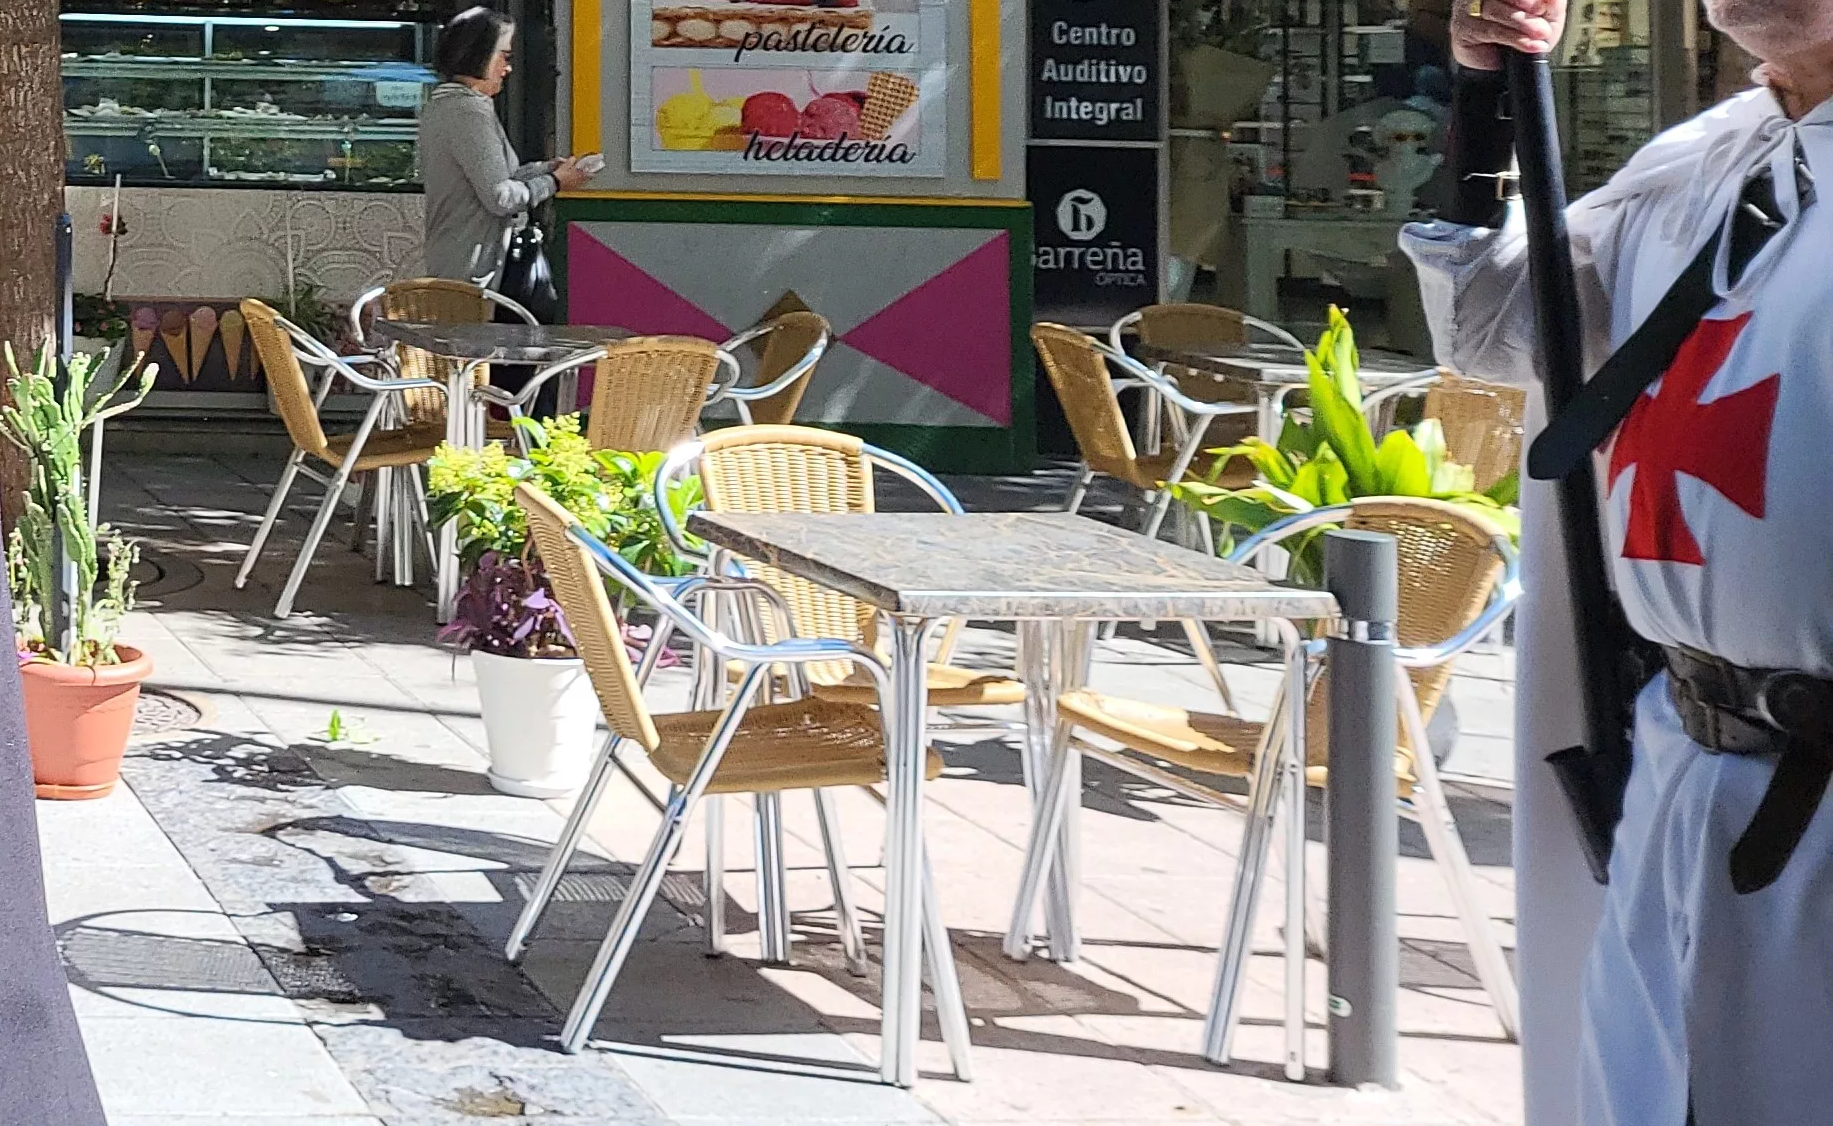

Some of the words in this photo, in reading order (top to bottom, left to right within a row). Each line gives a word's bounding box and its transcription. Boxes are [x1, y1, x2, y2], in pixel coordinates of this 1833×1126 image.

[733, 17, 915, 63] pastelería
[1051, 21, 1137, 47] Centro
[1041, 58, 1148, 84] Auditivo
[1044, 96, 1144, 125] Integral
[742, 130, 917, 165] heladería
[1031, 241, 1146, 271] arreña
